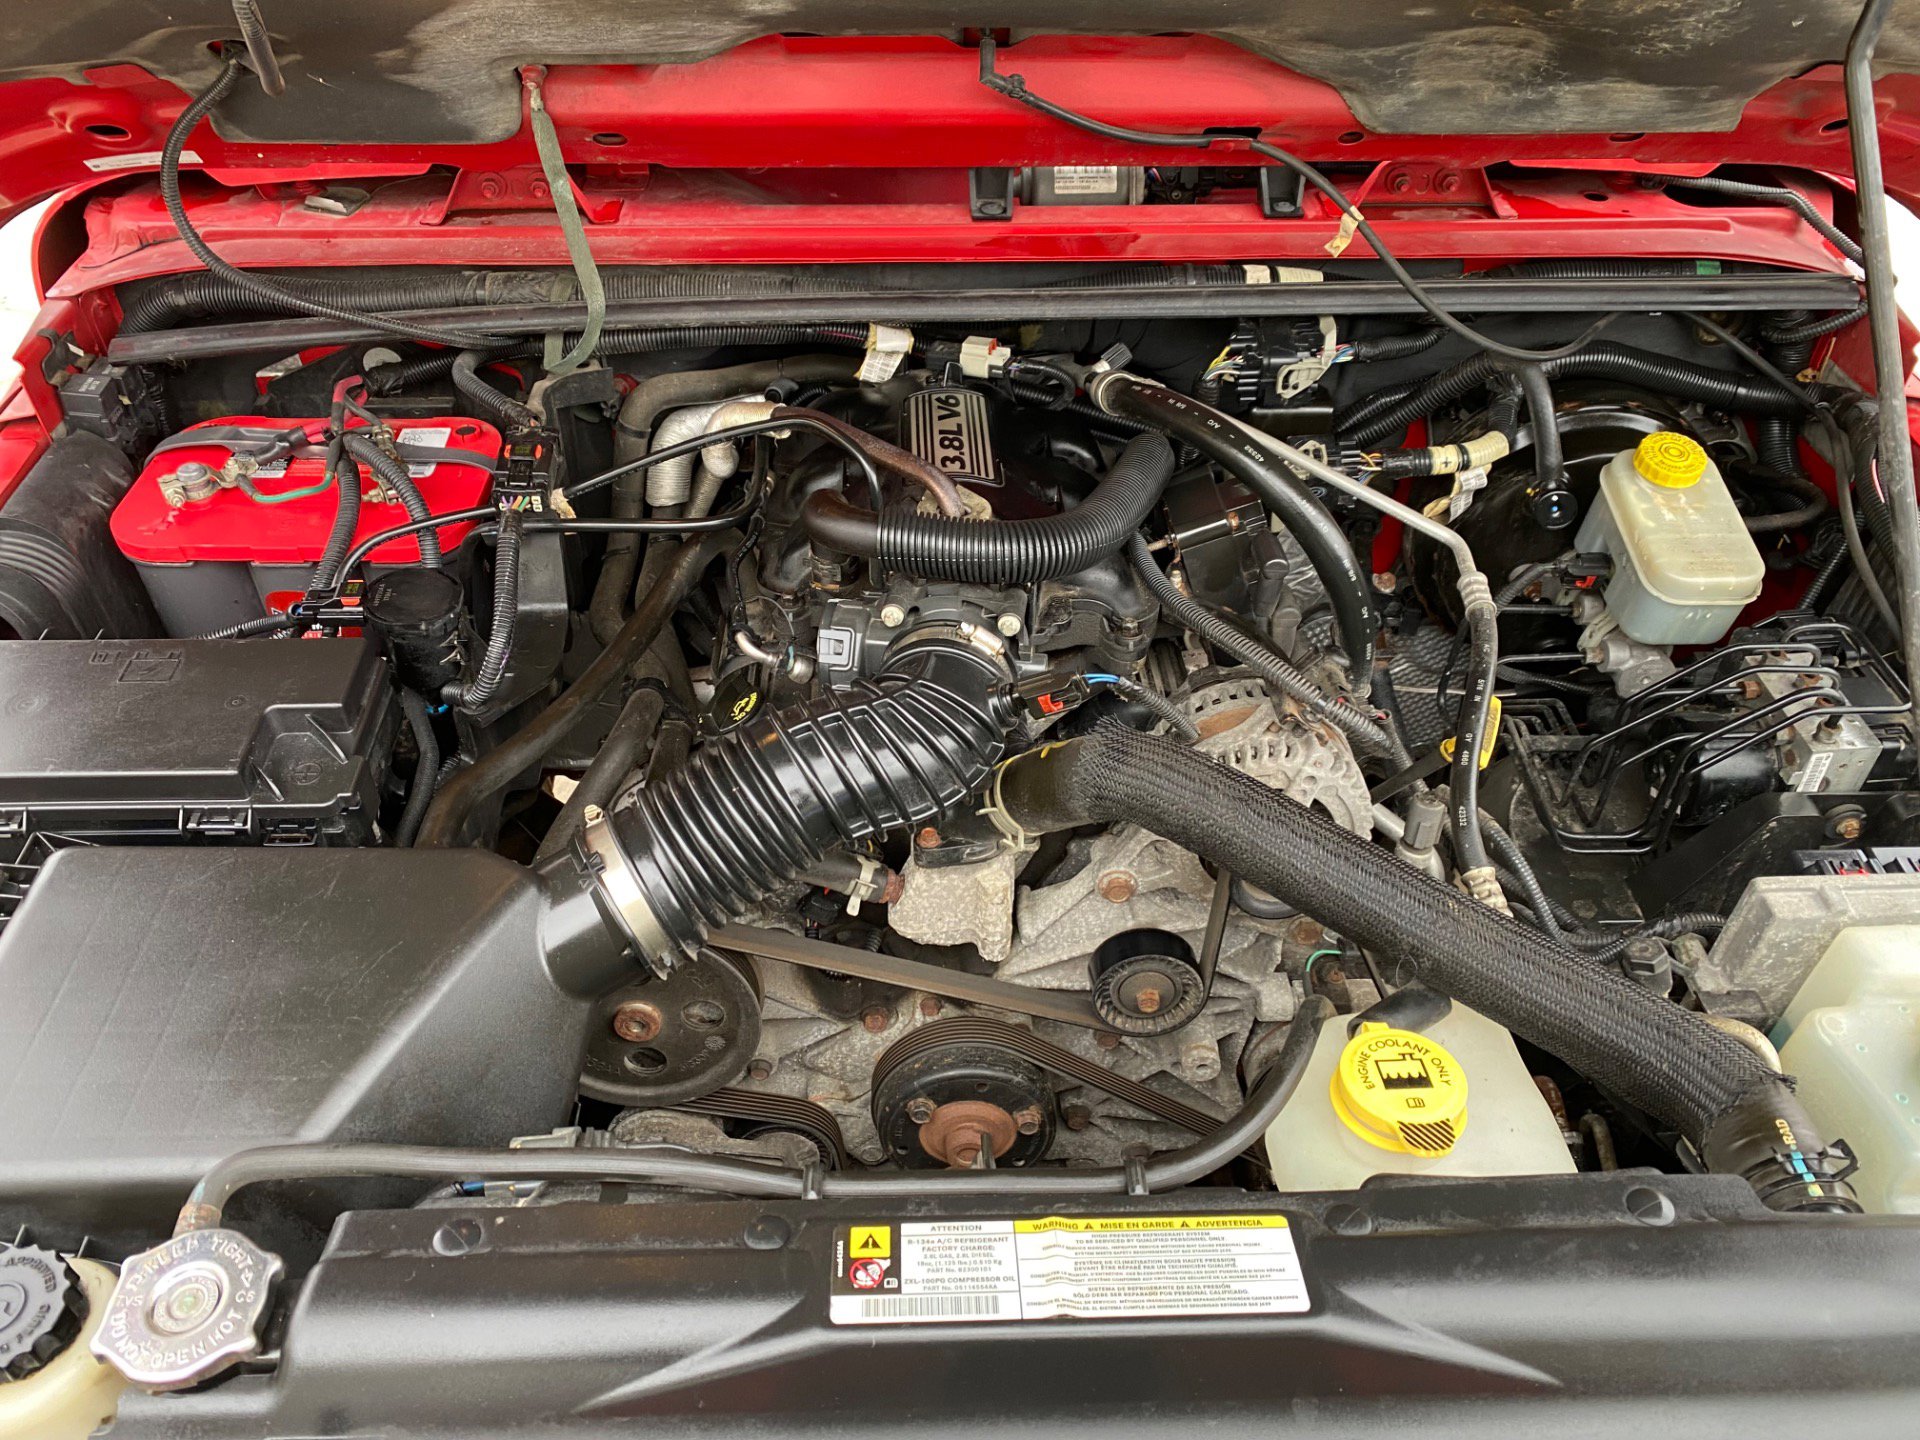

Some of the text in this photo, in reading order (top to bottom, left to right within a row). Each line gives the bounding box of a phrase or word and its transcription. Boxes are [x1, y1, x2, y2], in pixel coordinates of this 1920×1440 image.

[934, 394, 966, 470] 3.8L V6
[1358, 1038, 1452, 1090] ENGINE COOLANT ONLY
[1775, 1118, 1796, 1144] RAD
[1032, 1220, 1078, 1230] WARNING
[1142, 1220, 1174, 1228] GARDE
[1196, 1219, 1262, 1228] ADVERTENCIA
[210, 1236, 253, 1270] TIGHT
[150, 1341, 206, 1369] OPEN
[208, 1308, 242, 1346] HOT
